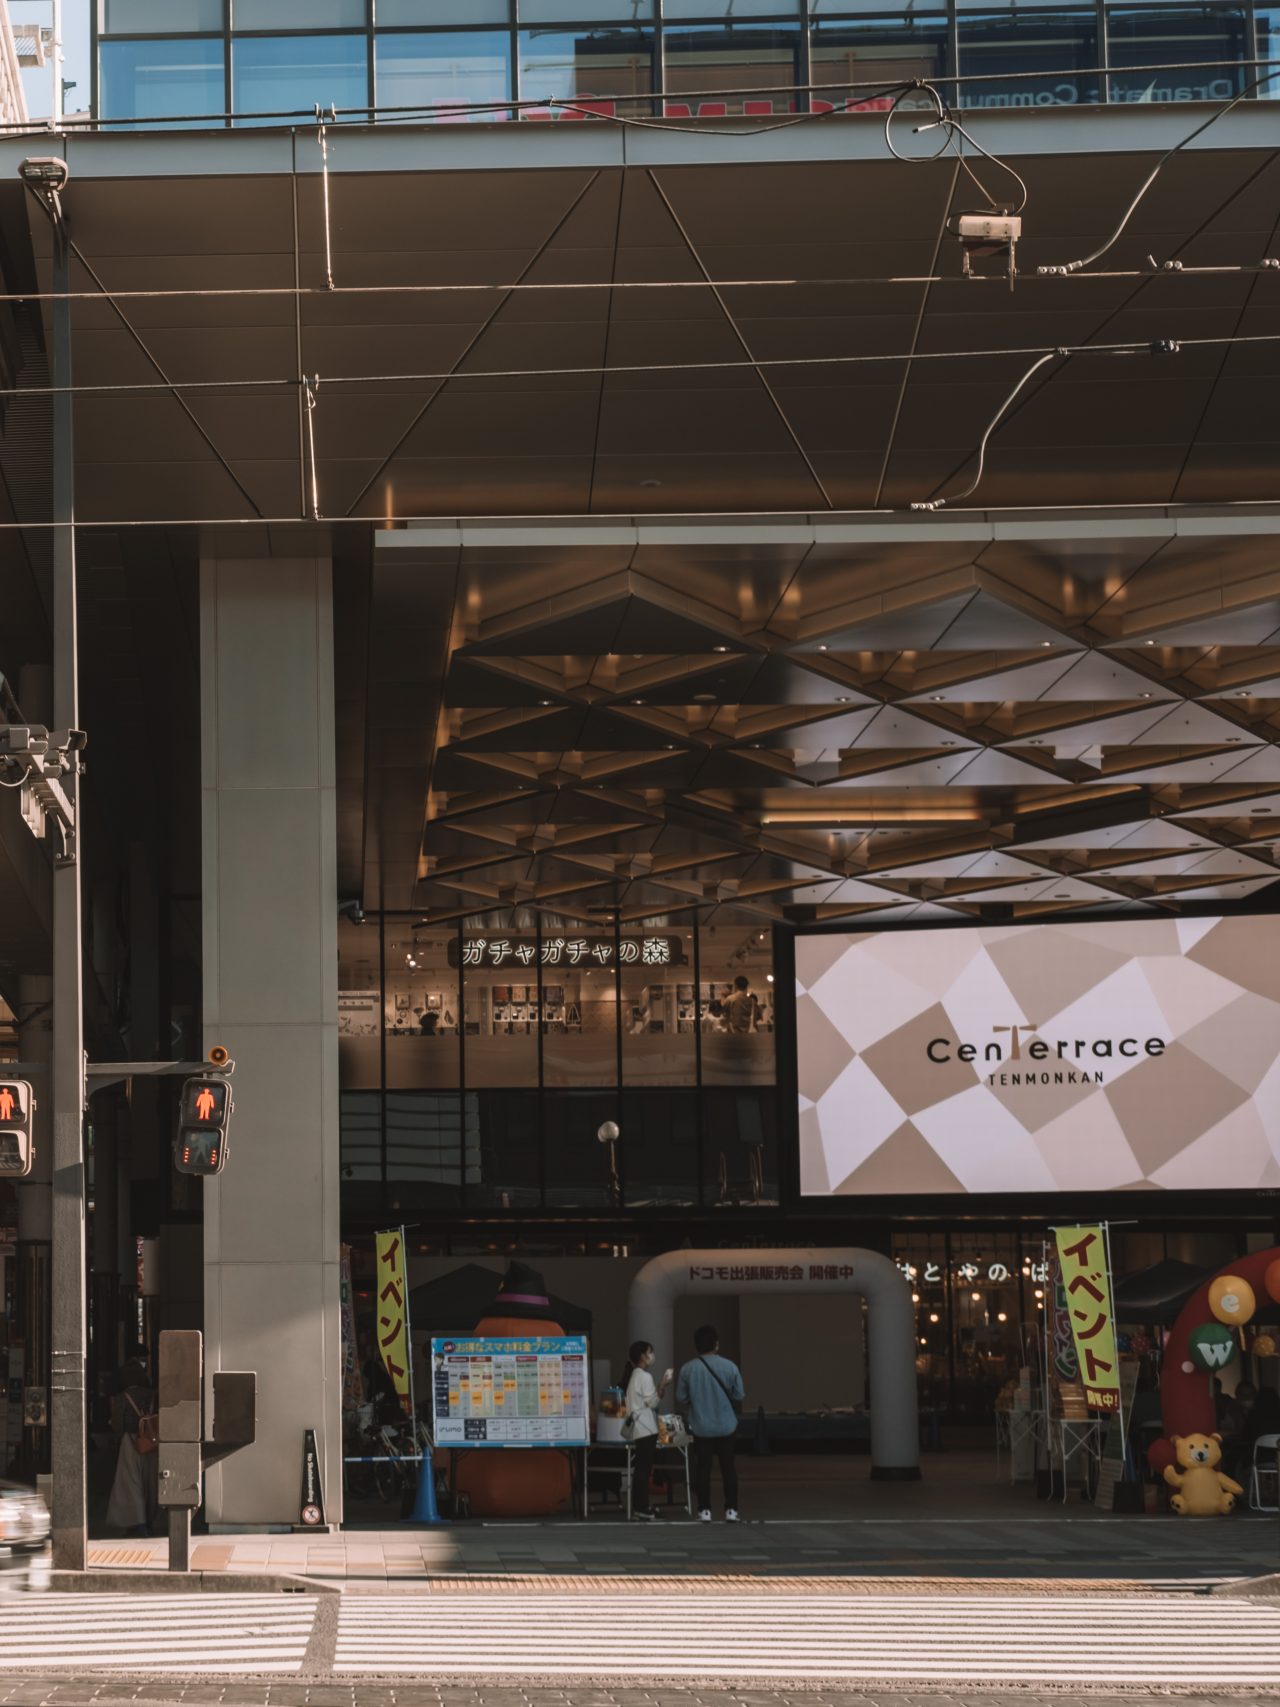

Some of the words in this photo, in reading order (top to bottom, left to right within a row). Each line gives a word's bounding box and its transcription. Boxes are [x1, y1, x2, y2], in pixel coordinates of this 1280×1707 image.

[462, 938, 671, 965] ガチャガチャの森
[988, 1071, 1104, 1086] TENMONKAN
[689, 1265, 804, 1281] ドコモ出張販売会
[808, 1264, 854, 1280] 開催中
[379, 1238, 405, 1379] イベント
[1063, 1232, 1112, 1381] イベント
